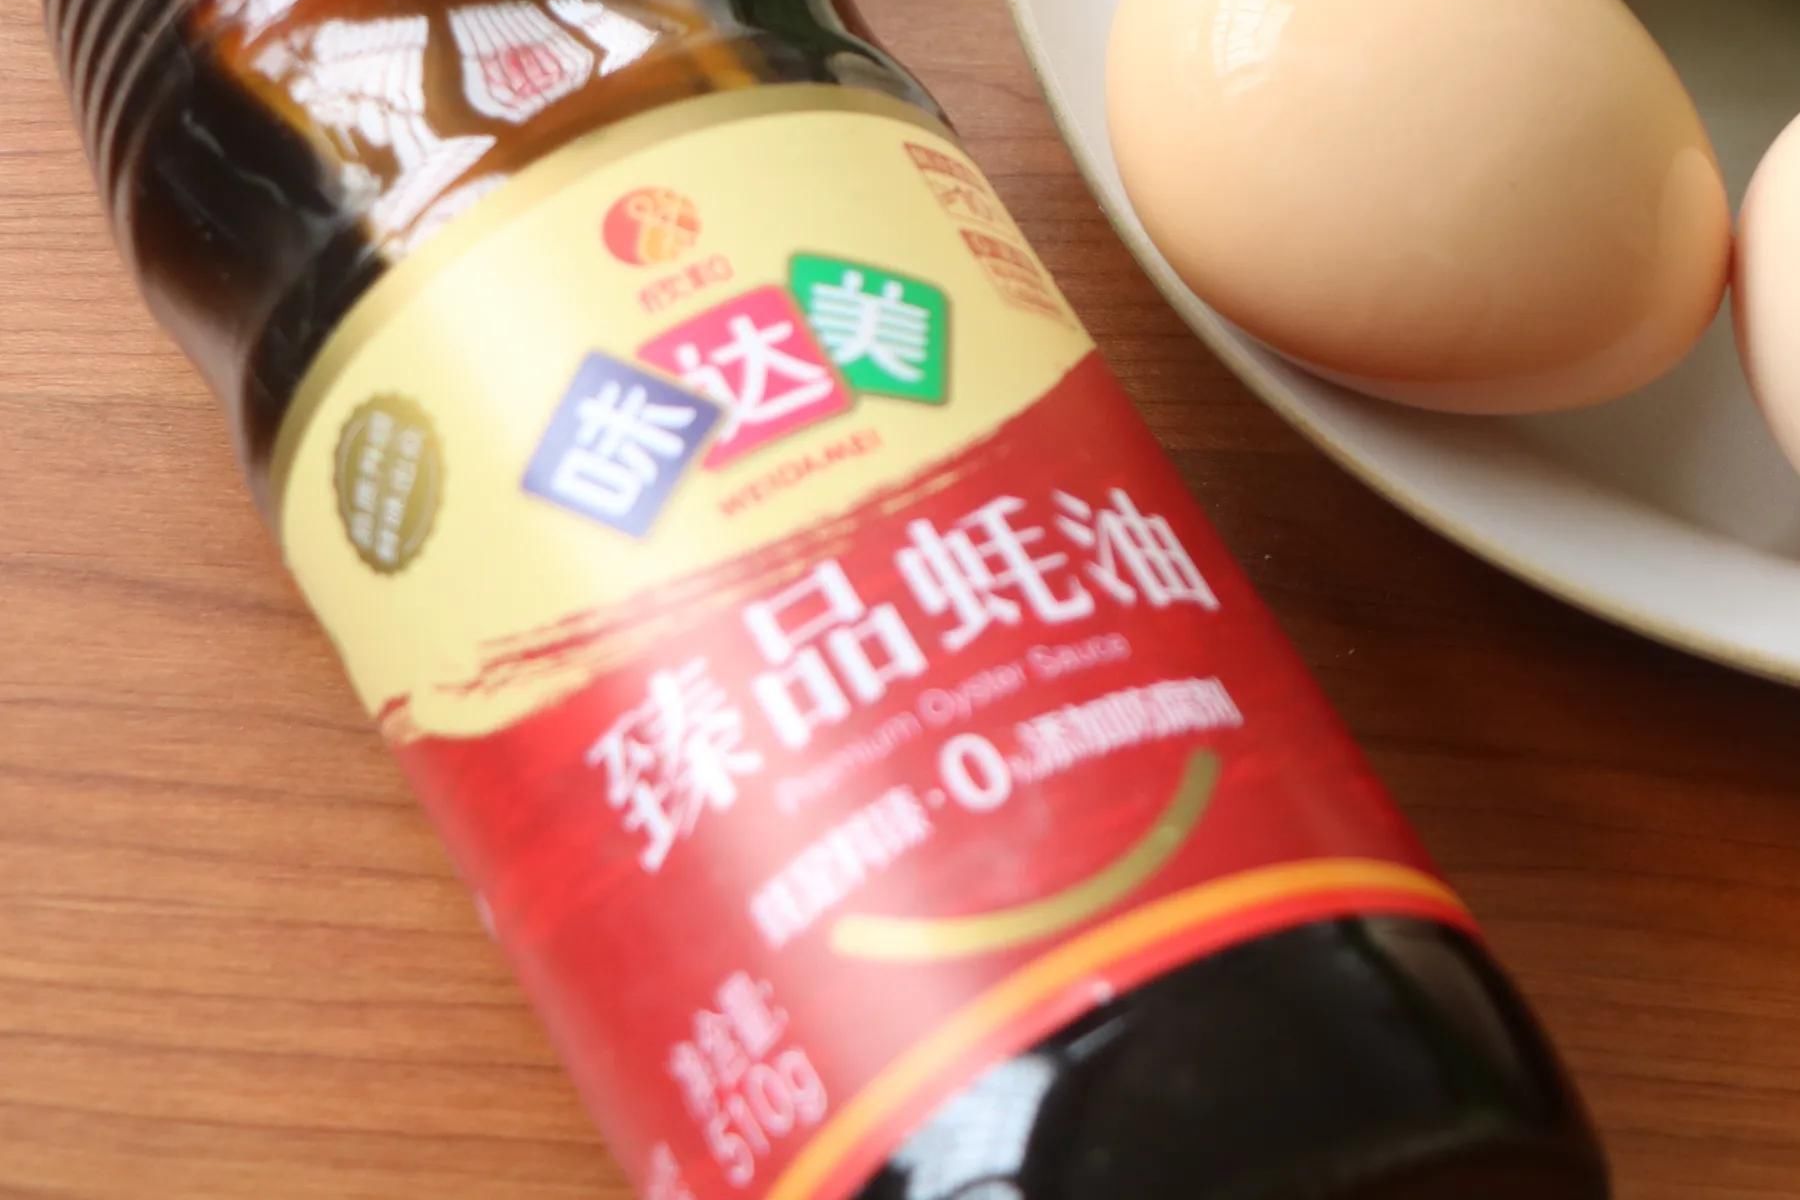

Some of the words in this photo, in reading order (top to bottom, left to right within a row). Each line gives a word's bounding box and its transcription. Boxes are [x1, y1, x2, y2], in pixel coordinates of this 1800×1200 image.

[551, 271, 931, 518] 味达美
[587, 487, 1219, 872] 臻品蚝油
[1028, 633, 1132, 691] Sauce
[704, 1048, 828, 1189] 510g
